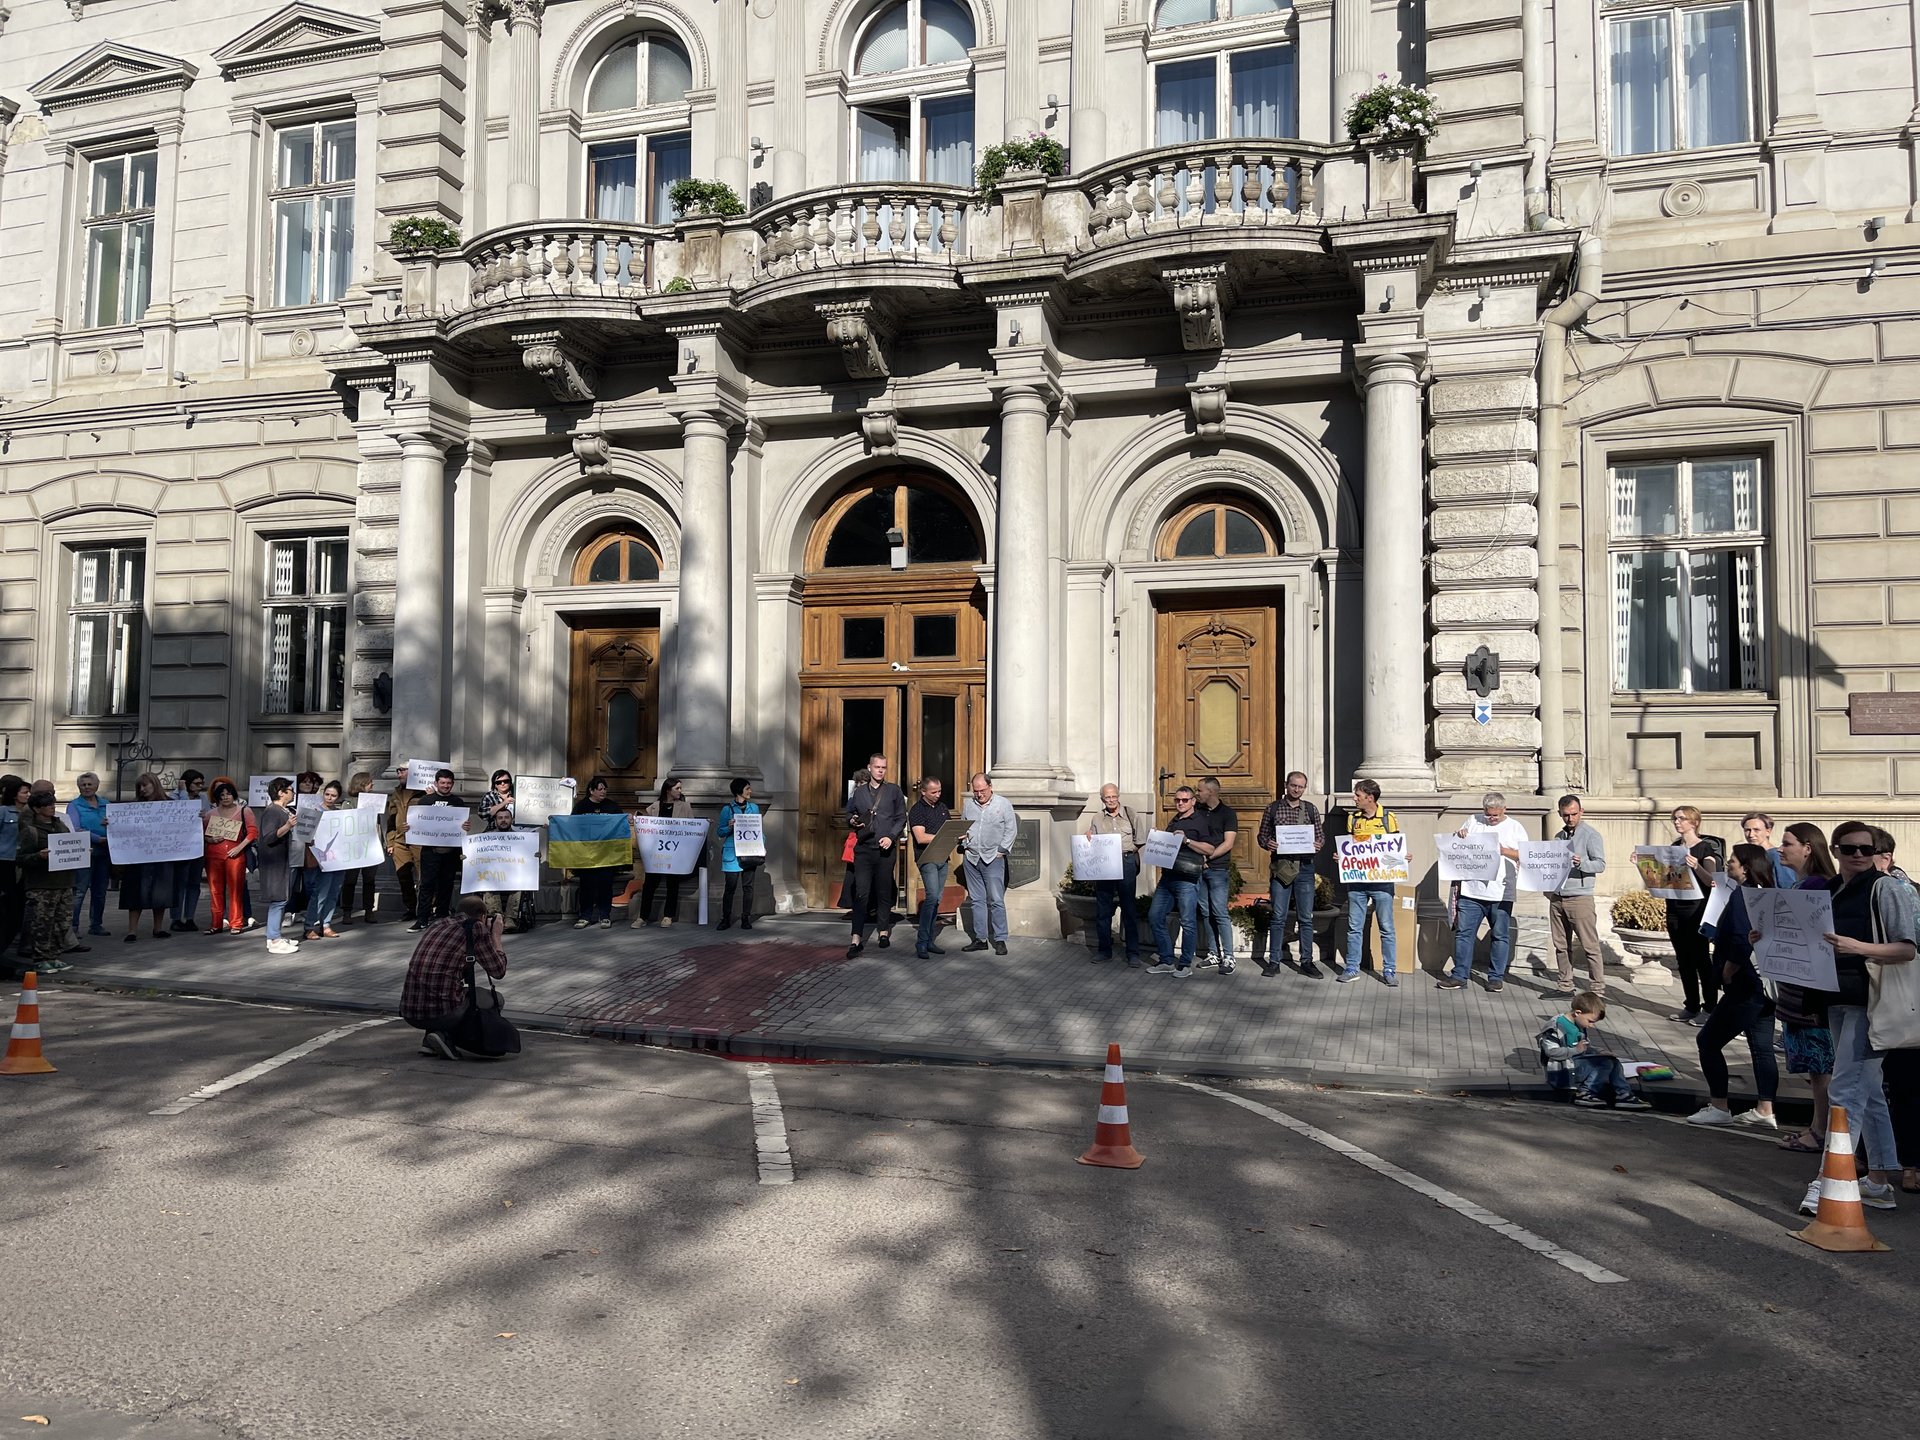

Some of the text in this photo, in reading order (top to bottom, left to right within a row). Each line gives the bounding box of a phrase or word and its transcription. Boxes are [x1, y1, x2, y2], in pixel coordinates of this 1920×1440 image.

[421, 830, 440, 838] нашу
[736, 830, 760, 841] ЗСУ
[657, 839, 680, 851] ЗСУ
[1451, 842, 1485, 852] Спочатку
[1528, 850, 1562, 859] Барабани
[1455, 862, 1488, 870] стадіони!
[1527, 862, 1561, 870] захистять
